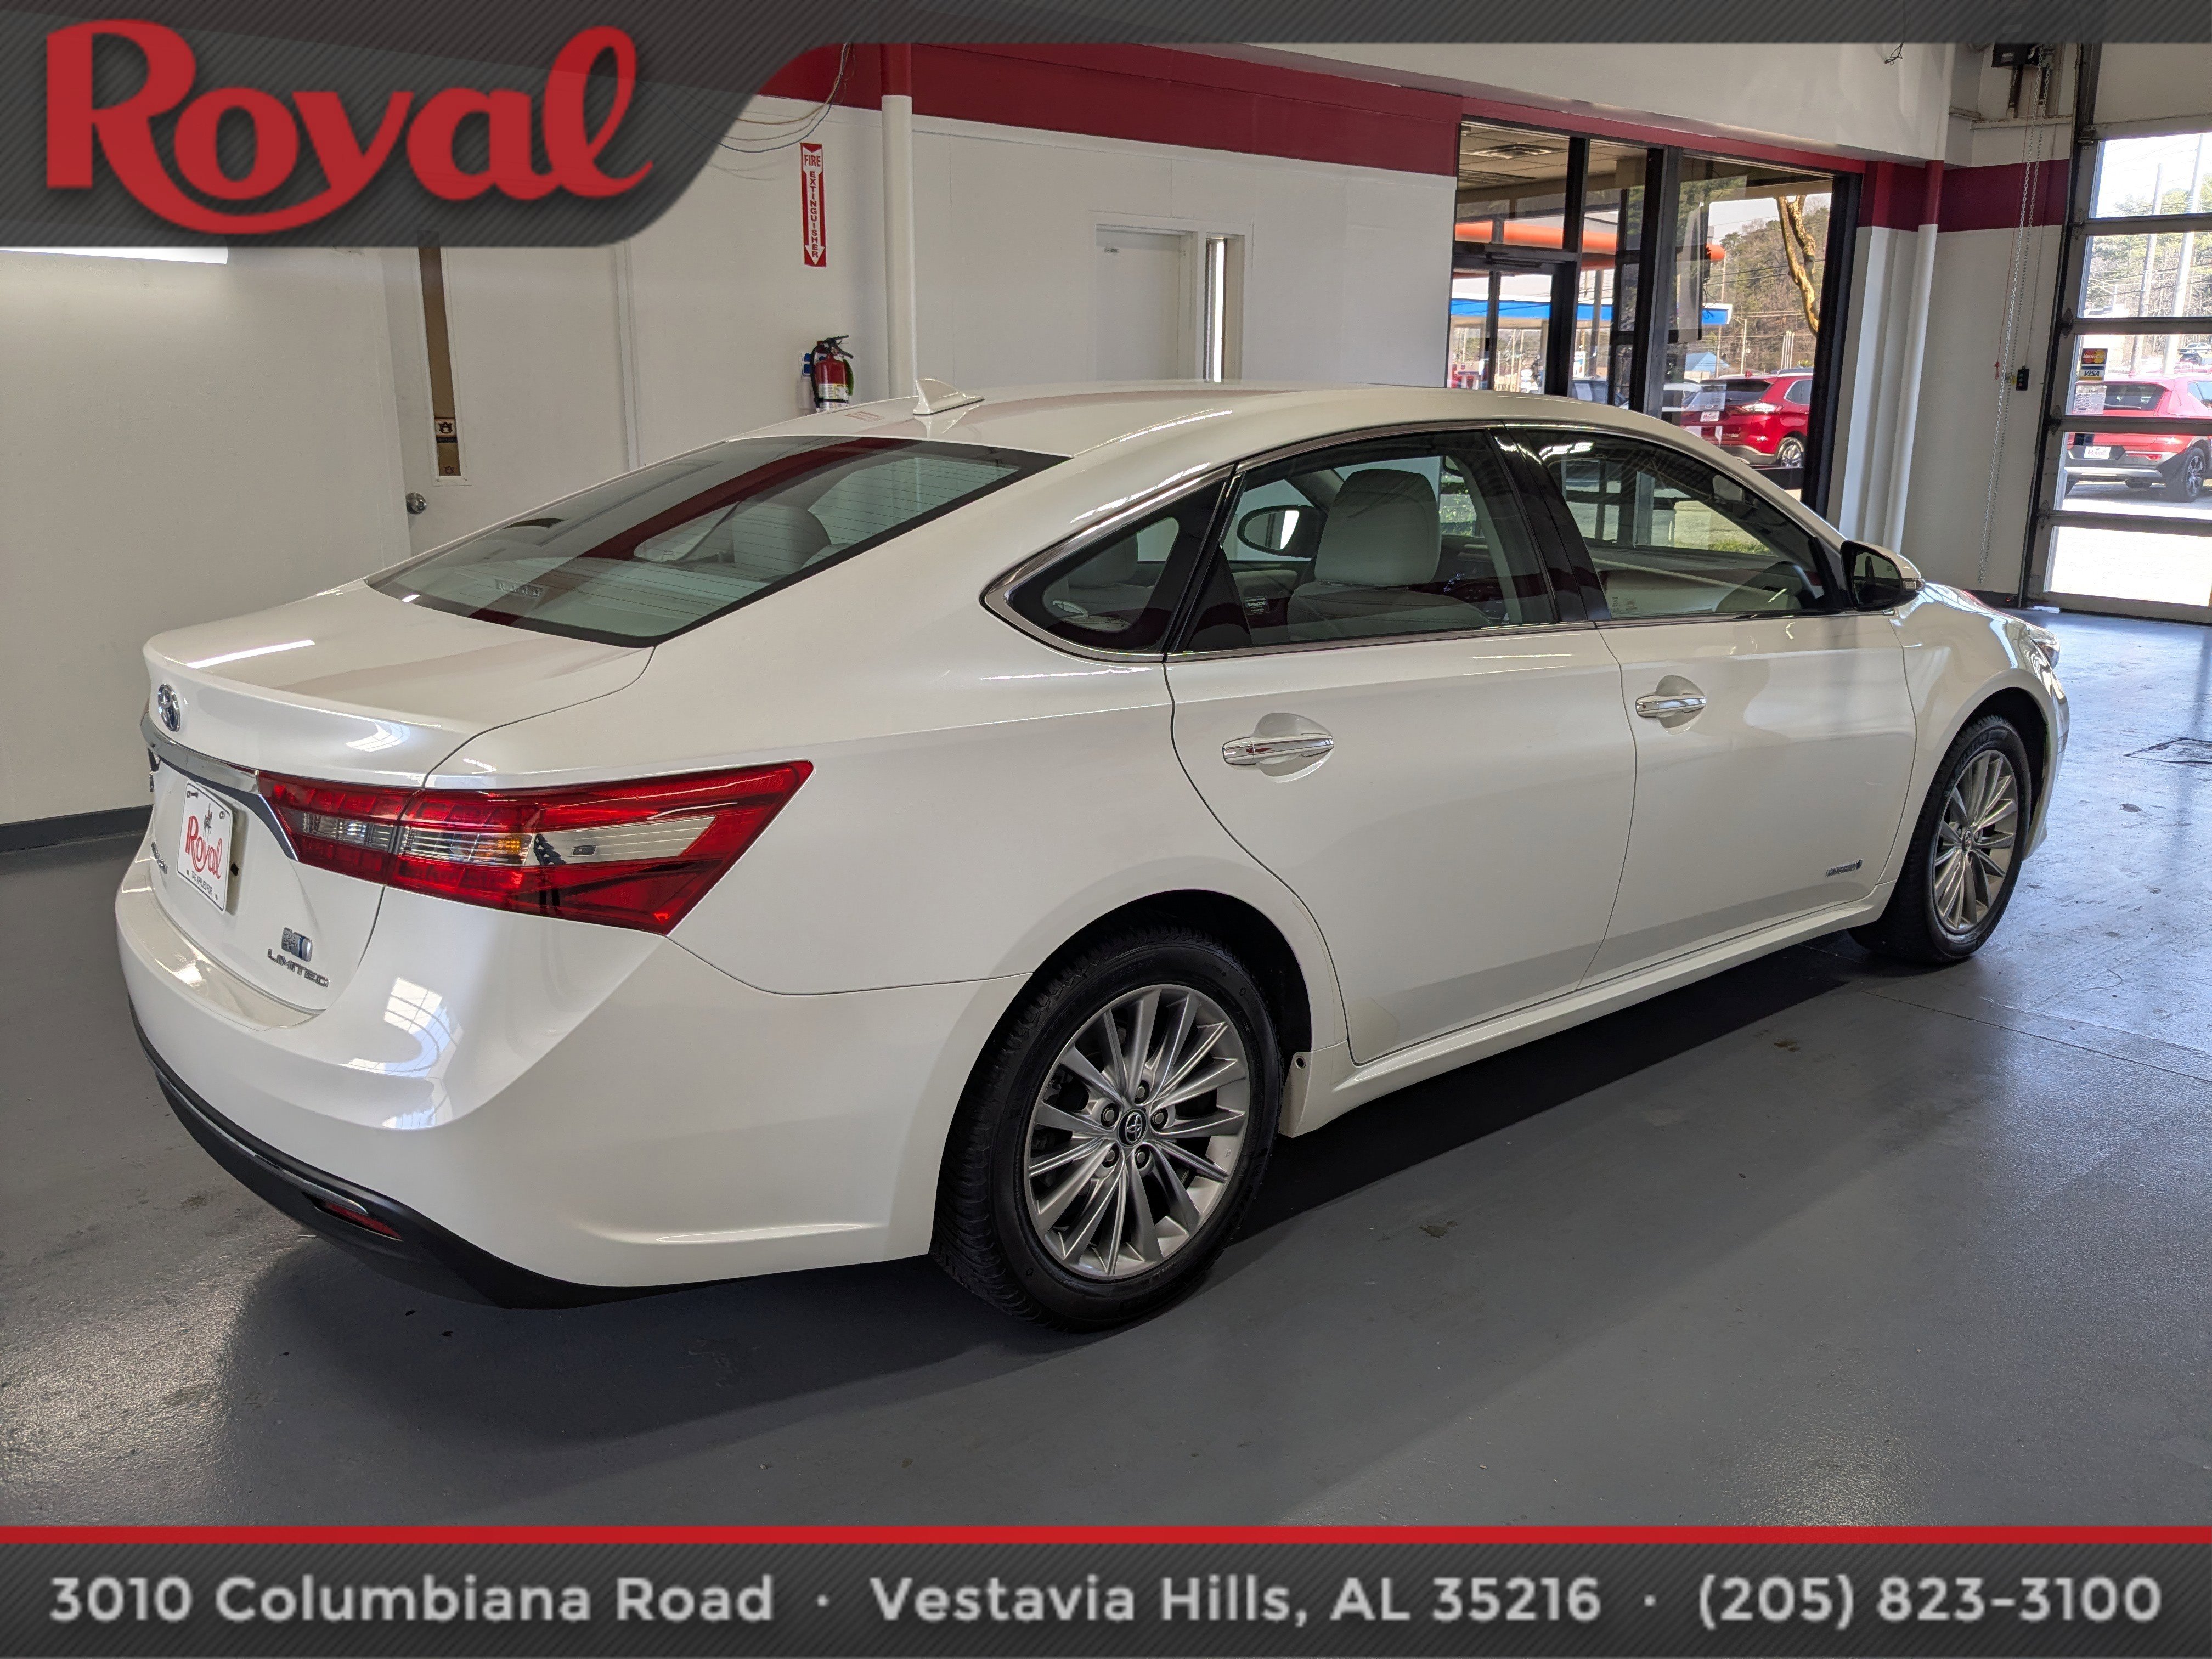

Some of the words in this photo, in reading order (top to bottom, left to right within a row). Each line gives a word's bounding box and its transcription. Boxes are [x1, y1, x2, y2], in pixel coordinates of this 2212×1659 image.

[804, 154, 821, 167] FIRE
[809, 170, 819, 258] EXTINGUISHER
[185, 815, 223, 880] Royal
[267, 948, 329, 988] LIMITED
